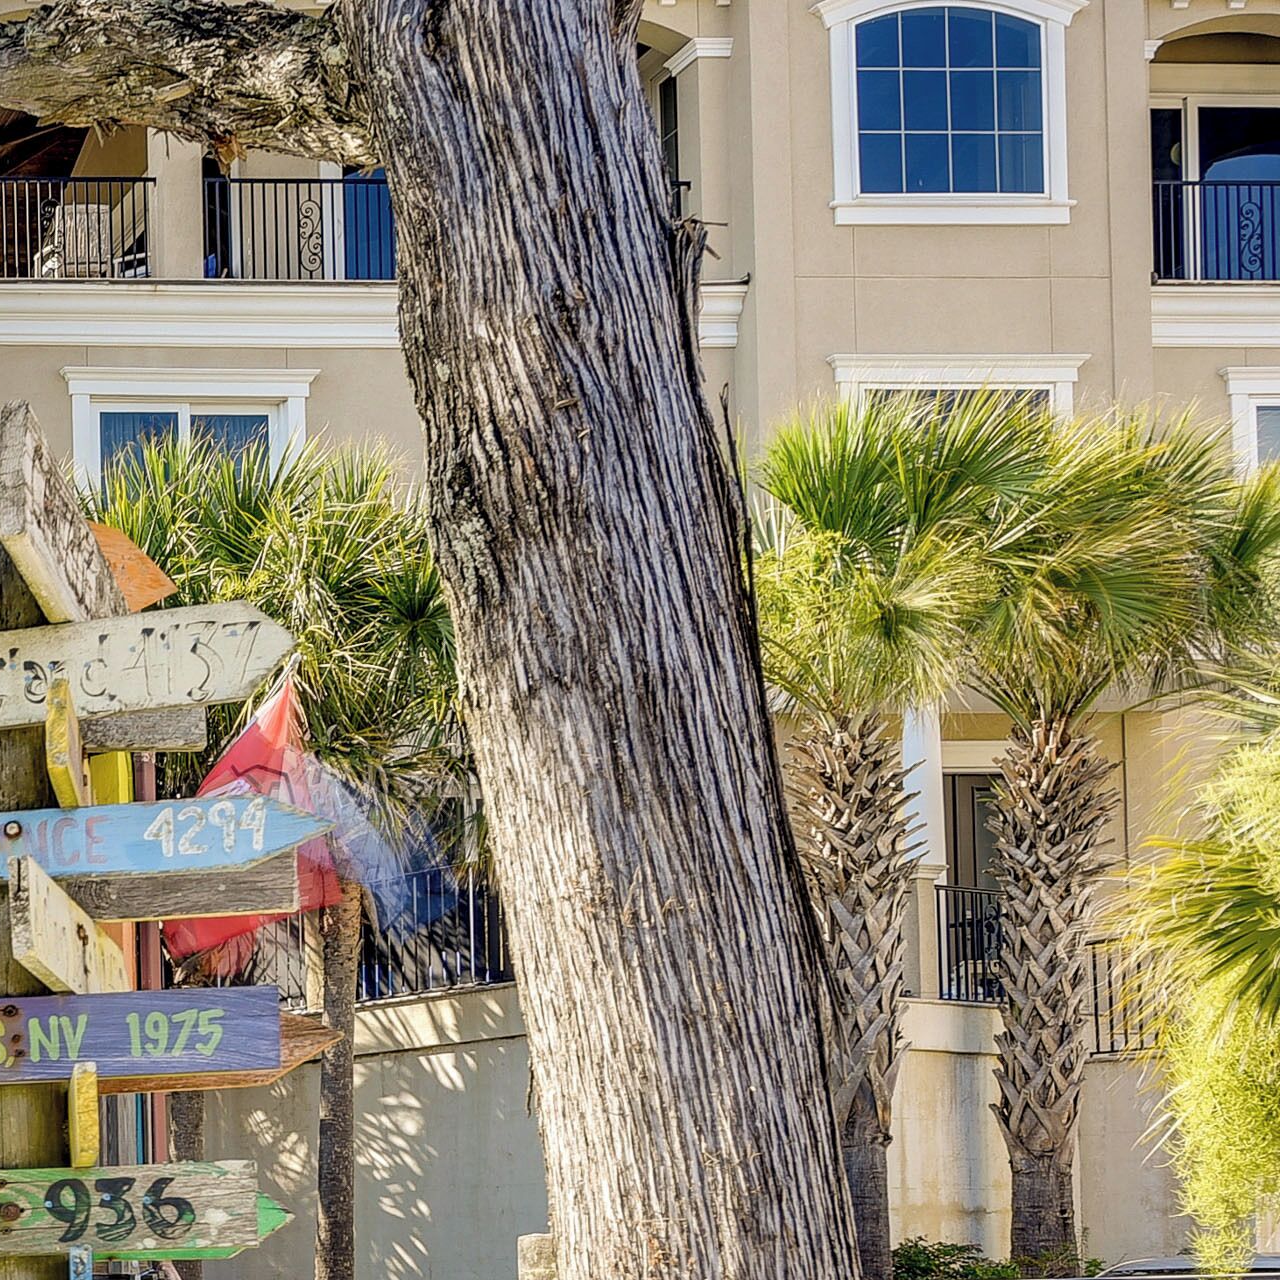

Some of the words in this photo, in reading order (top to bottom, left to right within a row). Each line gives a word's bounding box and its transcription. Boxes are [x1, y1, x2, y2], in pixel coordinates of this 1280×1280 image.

[143, 798, 267, 857] 4294
[30, 1014, 88, 1061] NV
[126, 1008, 225, 1058] 1975
[46, 1176, 195, 1243] 936
